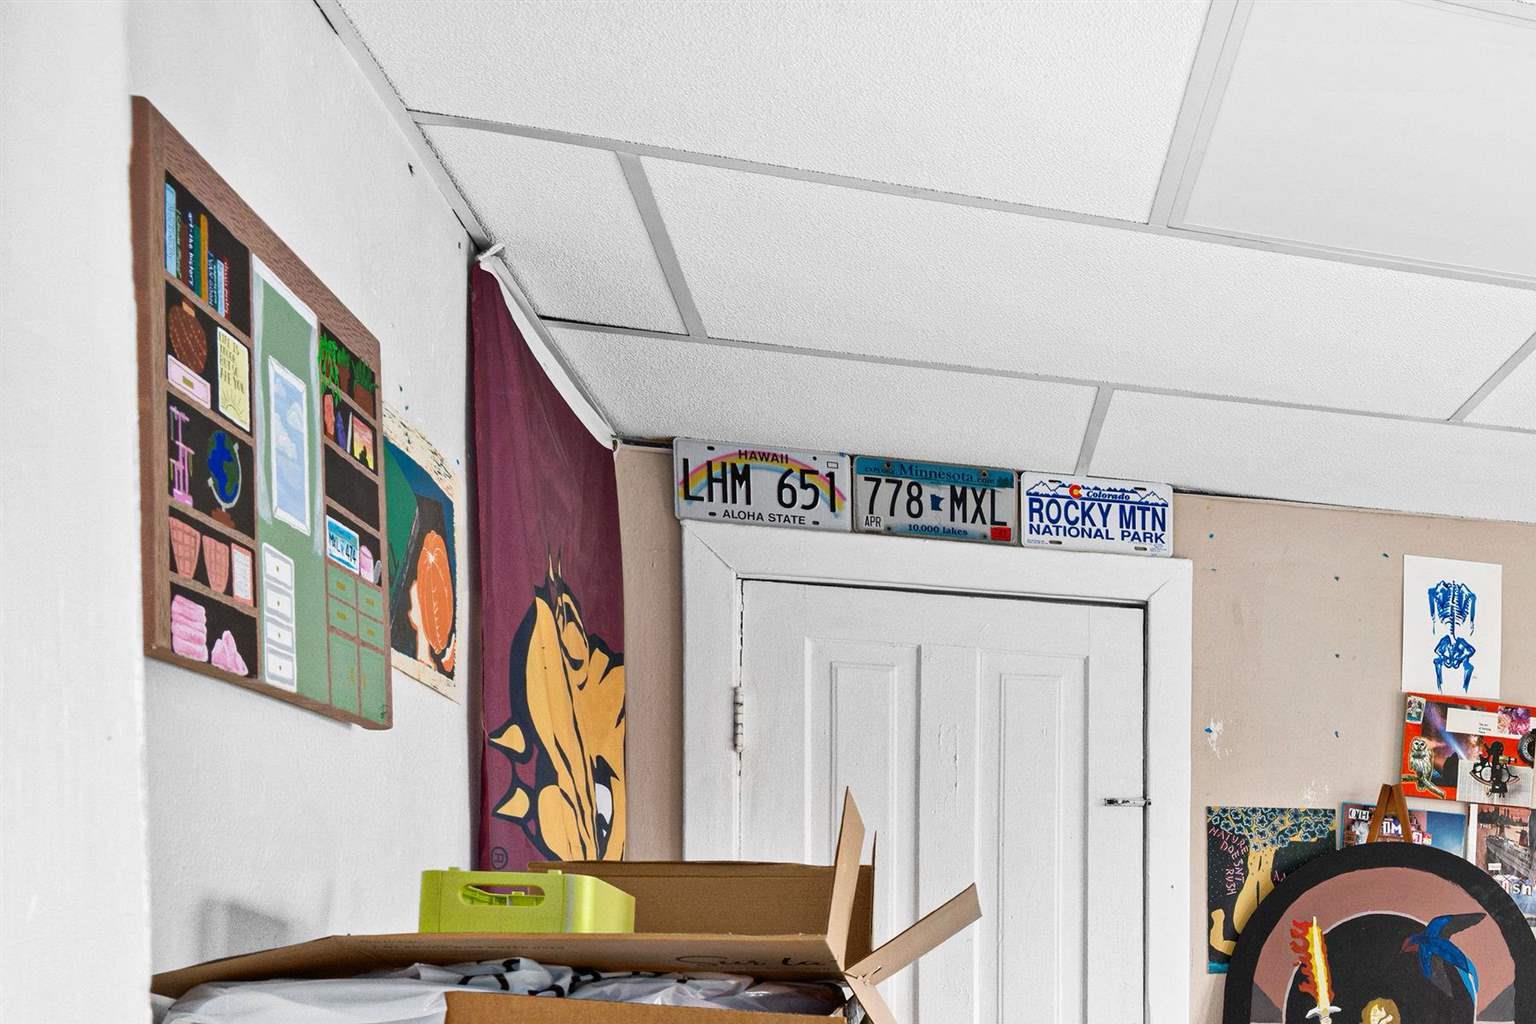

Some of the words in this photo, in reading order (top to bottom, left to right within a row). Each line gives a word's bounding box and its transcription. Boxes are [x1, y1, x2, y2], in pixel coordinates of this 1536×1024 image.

[738, 449, 789, 464] HAWAII
[683, 458, 751, 505] LHM
[777, 468, 836, 512] 651
[1086, 490, 1130, 501] Colorado
[863, 476, 924, 519] 778
[950, 484, 1007, 526] MXL
[722, 509, 765, 521] ALOHA
[768, 514, 806, 525] STATE
[864, 516, 882, 528] APR
[1028, 497, 1112, 528] ROCKY
[1119, 505, 1166, 532] MTN
[942, 527, 968, 537] lakes
[1029, 523, 1115, 541] NATIONAL
[1120, 530, 1166, 545] PARK
[1209, 827, 1249, 855] NATURE
[1225, 868, 1237, 896] RUSH
